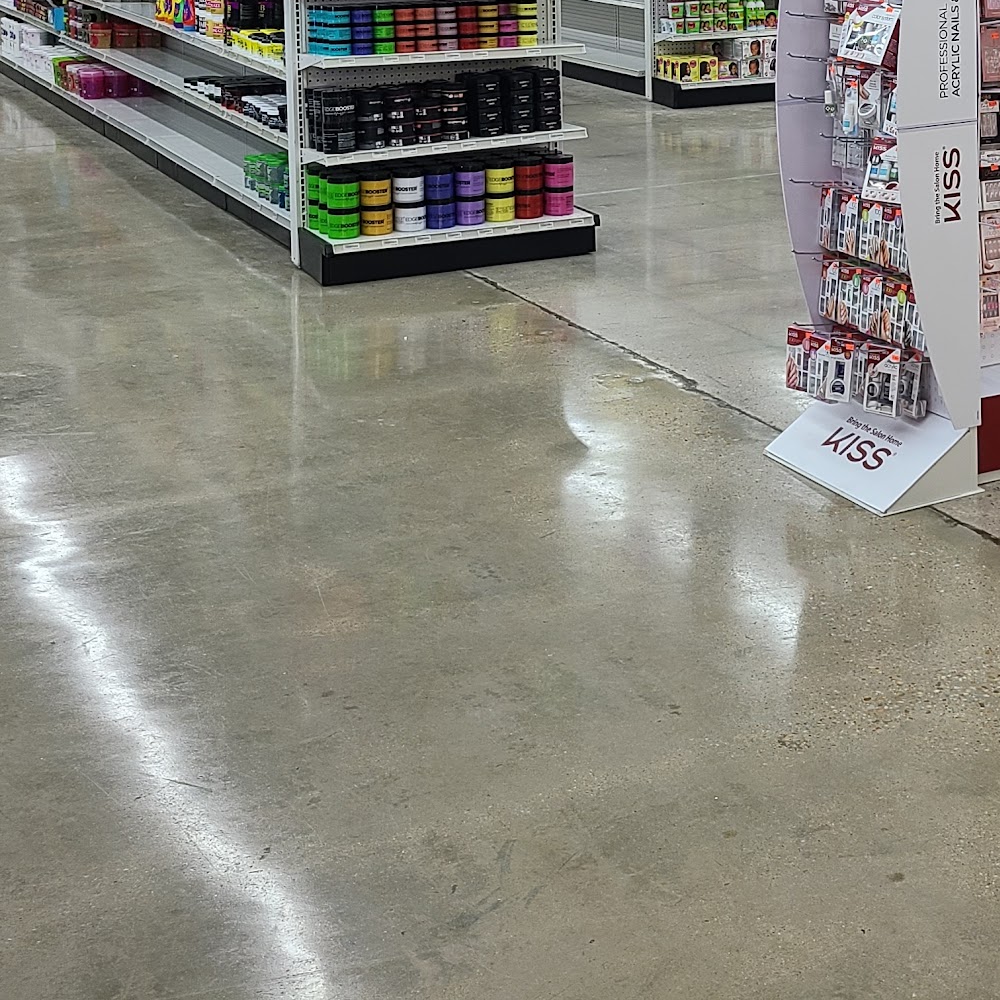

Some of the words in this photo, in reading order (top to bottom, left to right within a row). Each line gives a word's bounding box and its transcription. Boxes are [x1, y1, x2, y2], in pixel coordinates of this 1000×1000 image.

[951, 5, 960, 42] NAILS
[939, 3, 948, 99] PROFESSIONAL
[951, 44, 961, 97] ACRYLIC
[942, 148, 961, 222] KISS
[820, 426, 892, 470] KISS
[846, 416, 862, 430] Bring
[861, 422, 871, 433] the
[870, 428, 886, 440] Salon
[885, 434, 902, 447] Home
